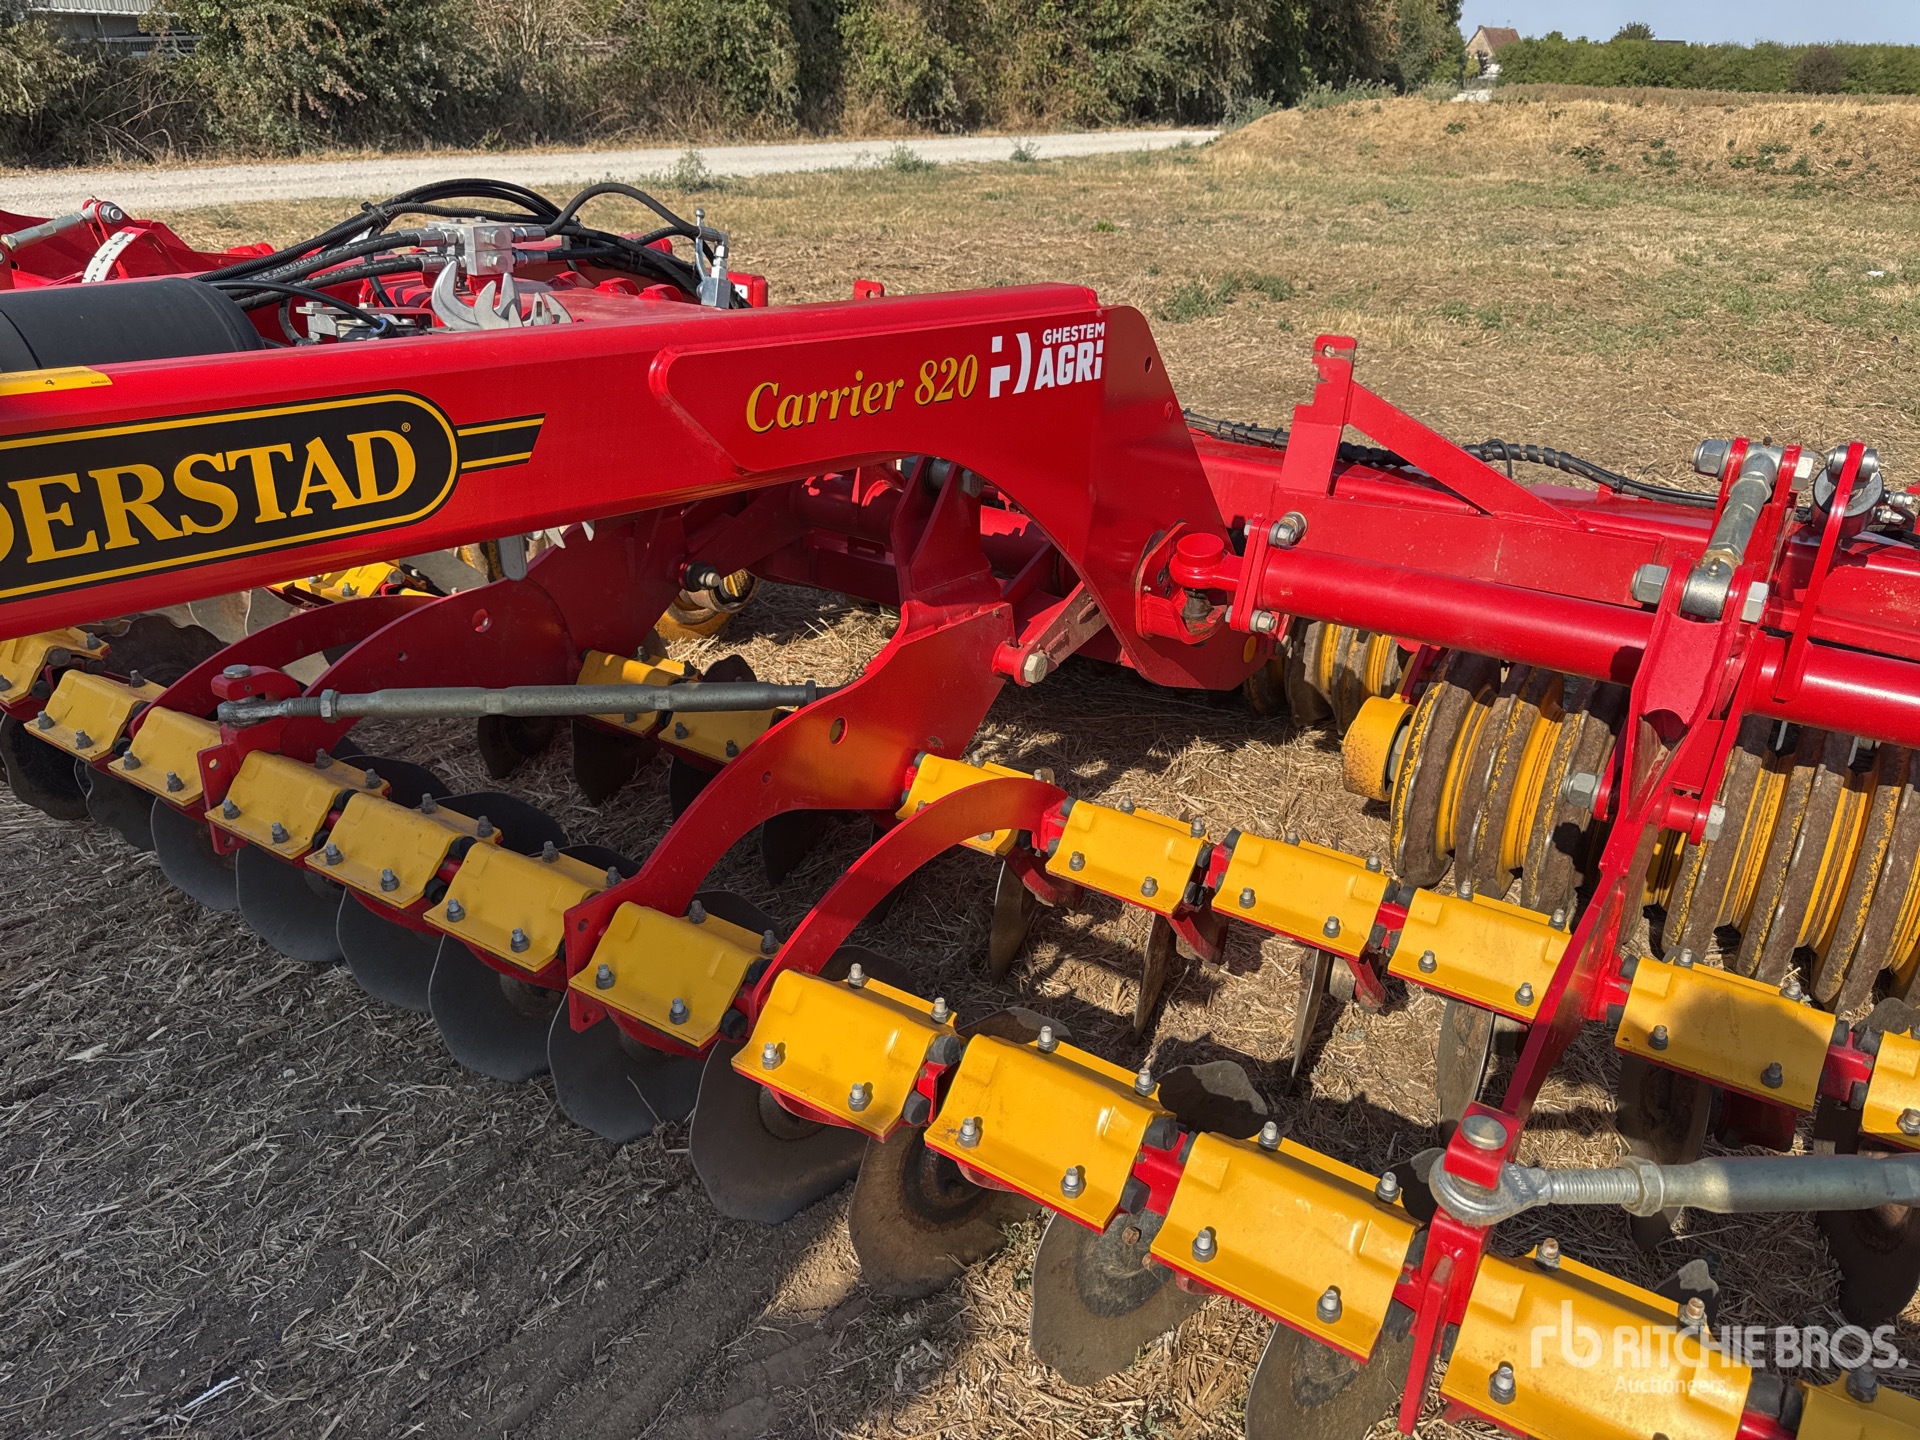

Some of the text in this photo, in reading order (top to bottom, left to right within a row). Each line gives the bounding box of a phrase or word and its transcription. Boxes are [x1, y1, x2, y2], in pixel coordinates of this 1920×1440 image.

[1043, 322, 1105, 345] GHESTEM
[745, 354, 979, 433] Carrier 820
[0, 431, 416, 563] ERSTAD
